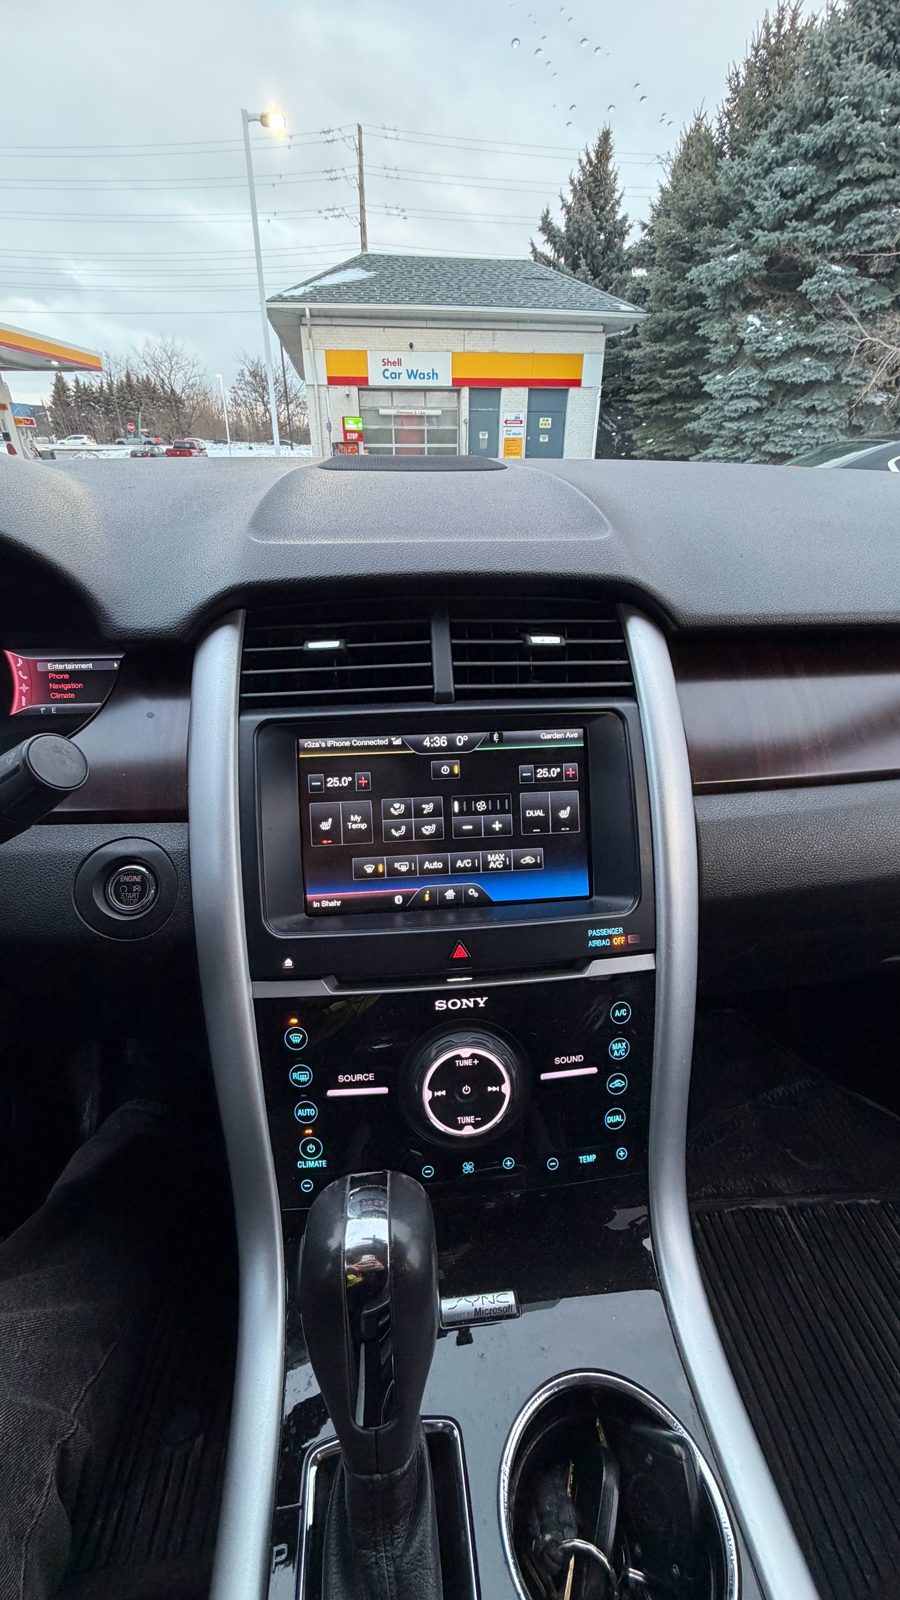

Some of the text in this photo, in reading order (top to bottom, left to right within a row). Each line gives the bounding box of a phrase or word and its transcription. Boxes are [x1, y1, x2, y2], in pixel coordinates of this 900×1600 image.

[381, 357, 402, 367] Shell
[382, 367, 439, 380] Car Wash
[346, 432, 359, 440] STOP
[47, 662, 93, 670] Entertainment
[49, 682, 84, 691] Navigation
[540, 732, 565, 740] Garden
[351, 738, 389, 746] Connected
[423, 736, 448, 748] 4:36
[536, 767, 561, 778] 25.0°
[326, 776, 352, 787] 25.0°
[526, 809, 545, 817] DUAL
[350, 814, 362, 822] My
[347, 822, 368, 830] Temp
[487, 853, 505, 862] MAX
[423, 861, 443, 869] Auto
[455, 859, 472, 868] A/C
[489, 860, 504, 869] A/C
[120, 875, 142, 883] ENGINE
[587, 927, 624, 937] PASSENGER
[588, 939, 611, 948] AIRBAG
[612, 936, 626, 946] OFF
[434, 996, 489, 1011] SONY
[614, 1008, 627, 1018] A/C
[612, 1042, 627, 1051] MAX
[613, 1049, 626, 1057] A/C
[554, 1054, 584, 1065] SOUND
[338, 1073, 375, 1083] SOURCE
[297, 1108, 315, 1117] AUTO
[606, 1115, 624, 1124] DUAL
[578, 1154, 597, 1164] TEMP
[297, 1160, 327, 1169] CLIMATE
[447, 1292, 509, 1311] SYNC
[473, 1304, 513, 1317] Microsoft
